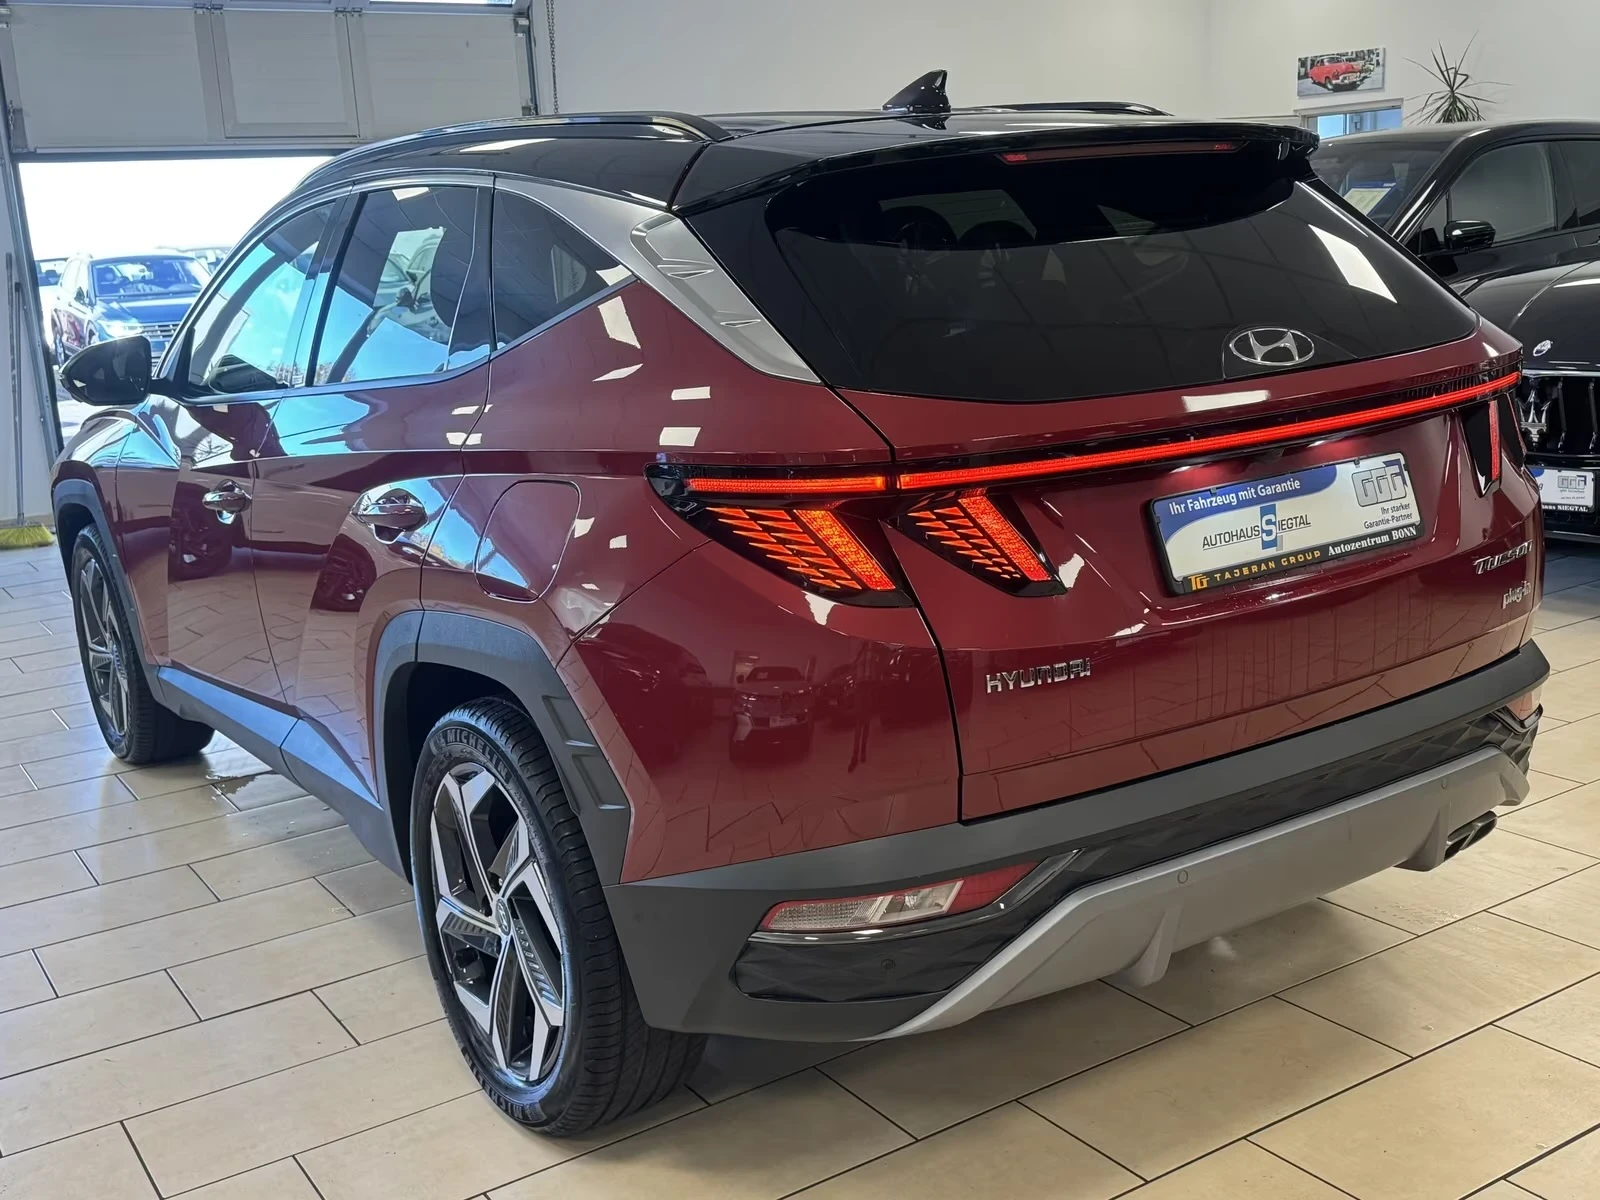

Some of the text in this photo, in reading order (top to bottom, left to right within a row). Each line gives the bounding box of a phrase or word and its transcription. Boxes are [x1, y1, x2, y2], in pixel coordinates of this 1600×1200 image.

[1169, 478, 1301, 515] Ihr Fahrzeug mit Garantie
[1381, 502, 1411, 515] Ihr starker
[1557, 504, 1588, 512] SIEGTAL
[1363, 512, 1413, 529] Garantie-Partner
[1202, 525, 1260, 548] AUTOHAUS
[1328, 526, 1417, 556] Autozentrum BONN
[1214, 561, 1276, 582] TAJERAN
[1281, 550, 1321, 566] GROUP
[986, 657, 1091, 693] HYUNDAI
[446, 728, 511, 781] MICHELIN
